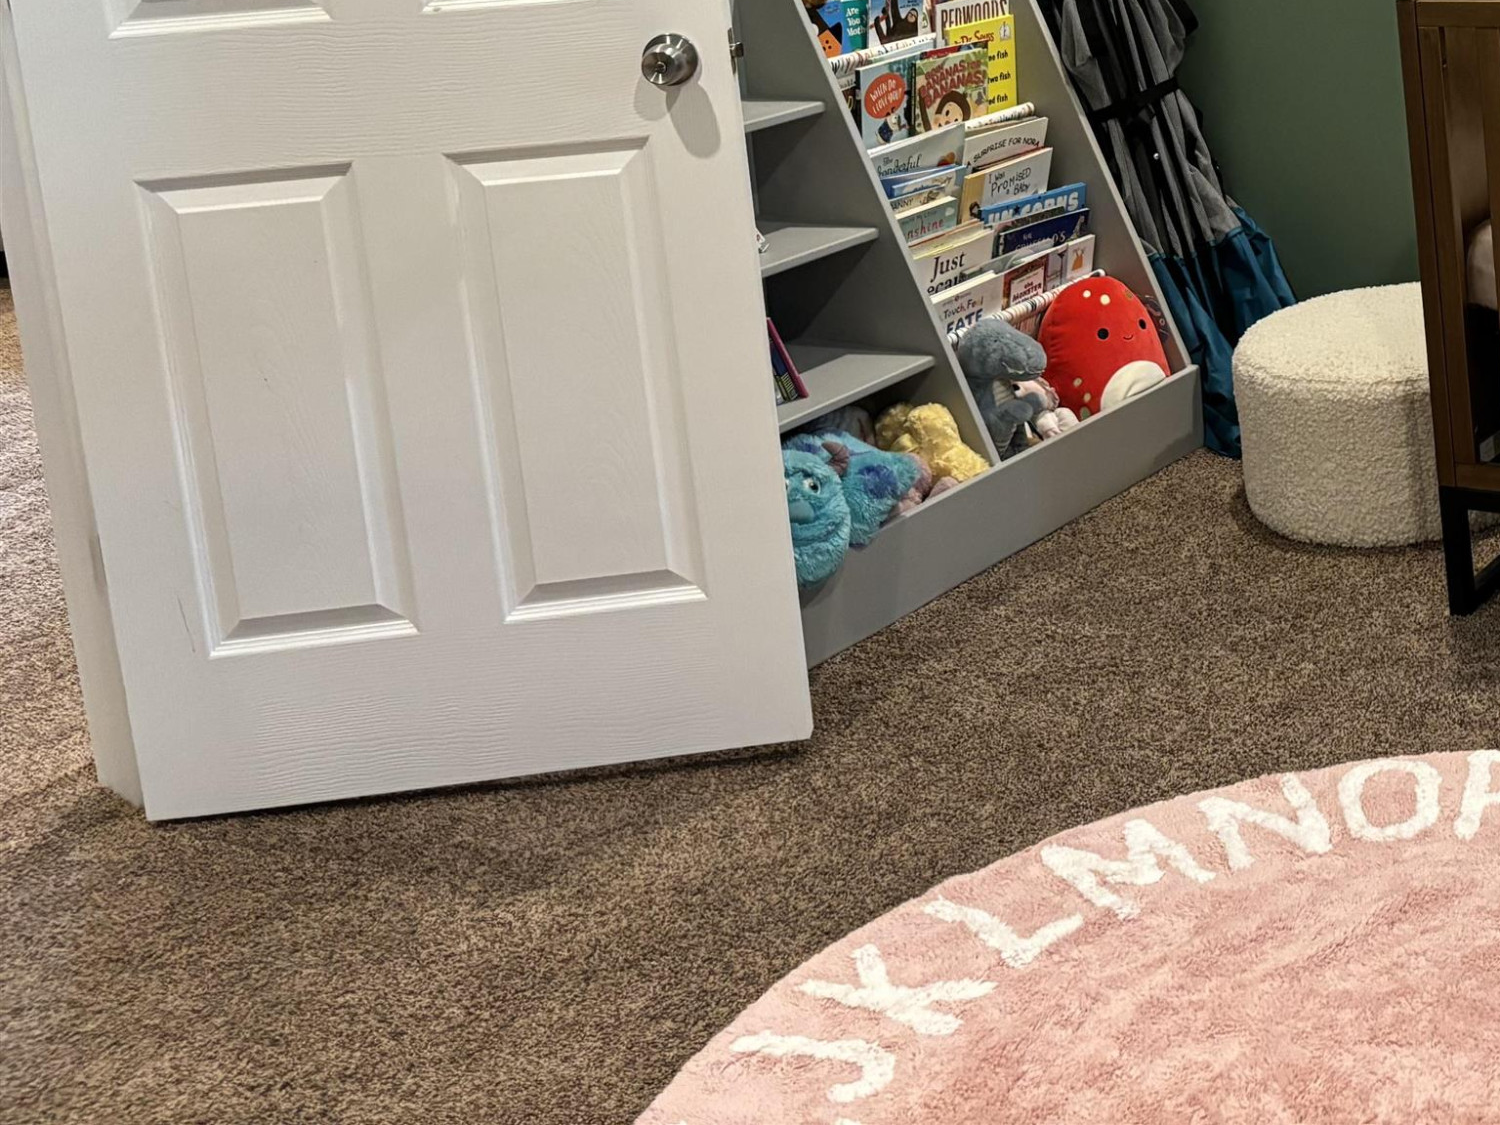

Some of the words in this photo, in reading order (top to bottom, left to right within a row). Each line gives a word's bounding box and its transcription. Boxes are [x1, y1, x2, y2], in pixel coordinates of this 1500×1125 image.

[846, 7, 859, 17] Are
[846, 17, 861, 27] You
[846, 26, 867, 37] Moth
[996, 50, 1008, 60] fish
[999, 71, 1011, 81] fish
[988, 96, 996, 105] ed
[996, 93, 1008, 103] fish
[973, 138, 1008, 163] SURPRISE
[1008, 137, 1022, 147] FOR
[1022, 136, 1040, 147] NORA
[988, 172, 993, 184] I
[988, 191, 1079, 224] UNCORNS
[907, 218, 945, 239] nshine
[930, 251, 966, 283] Just
